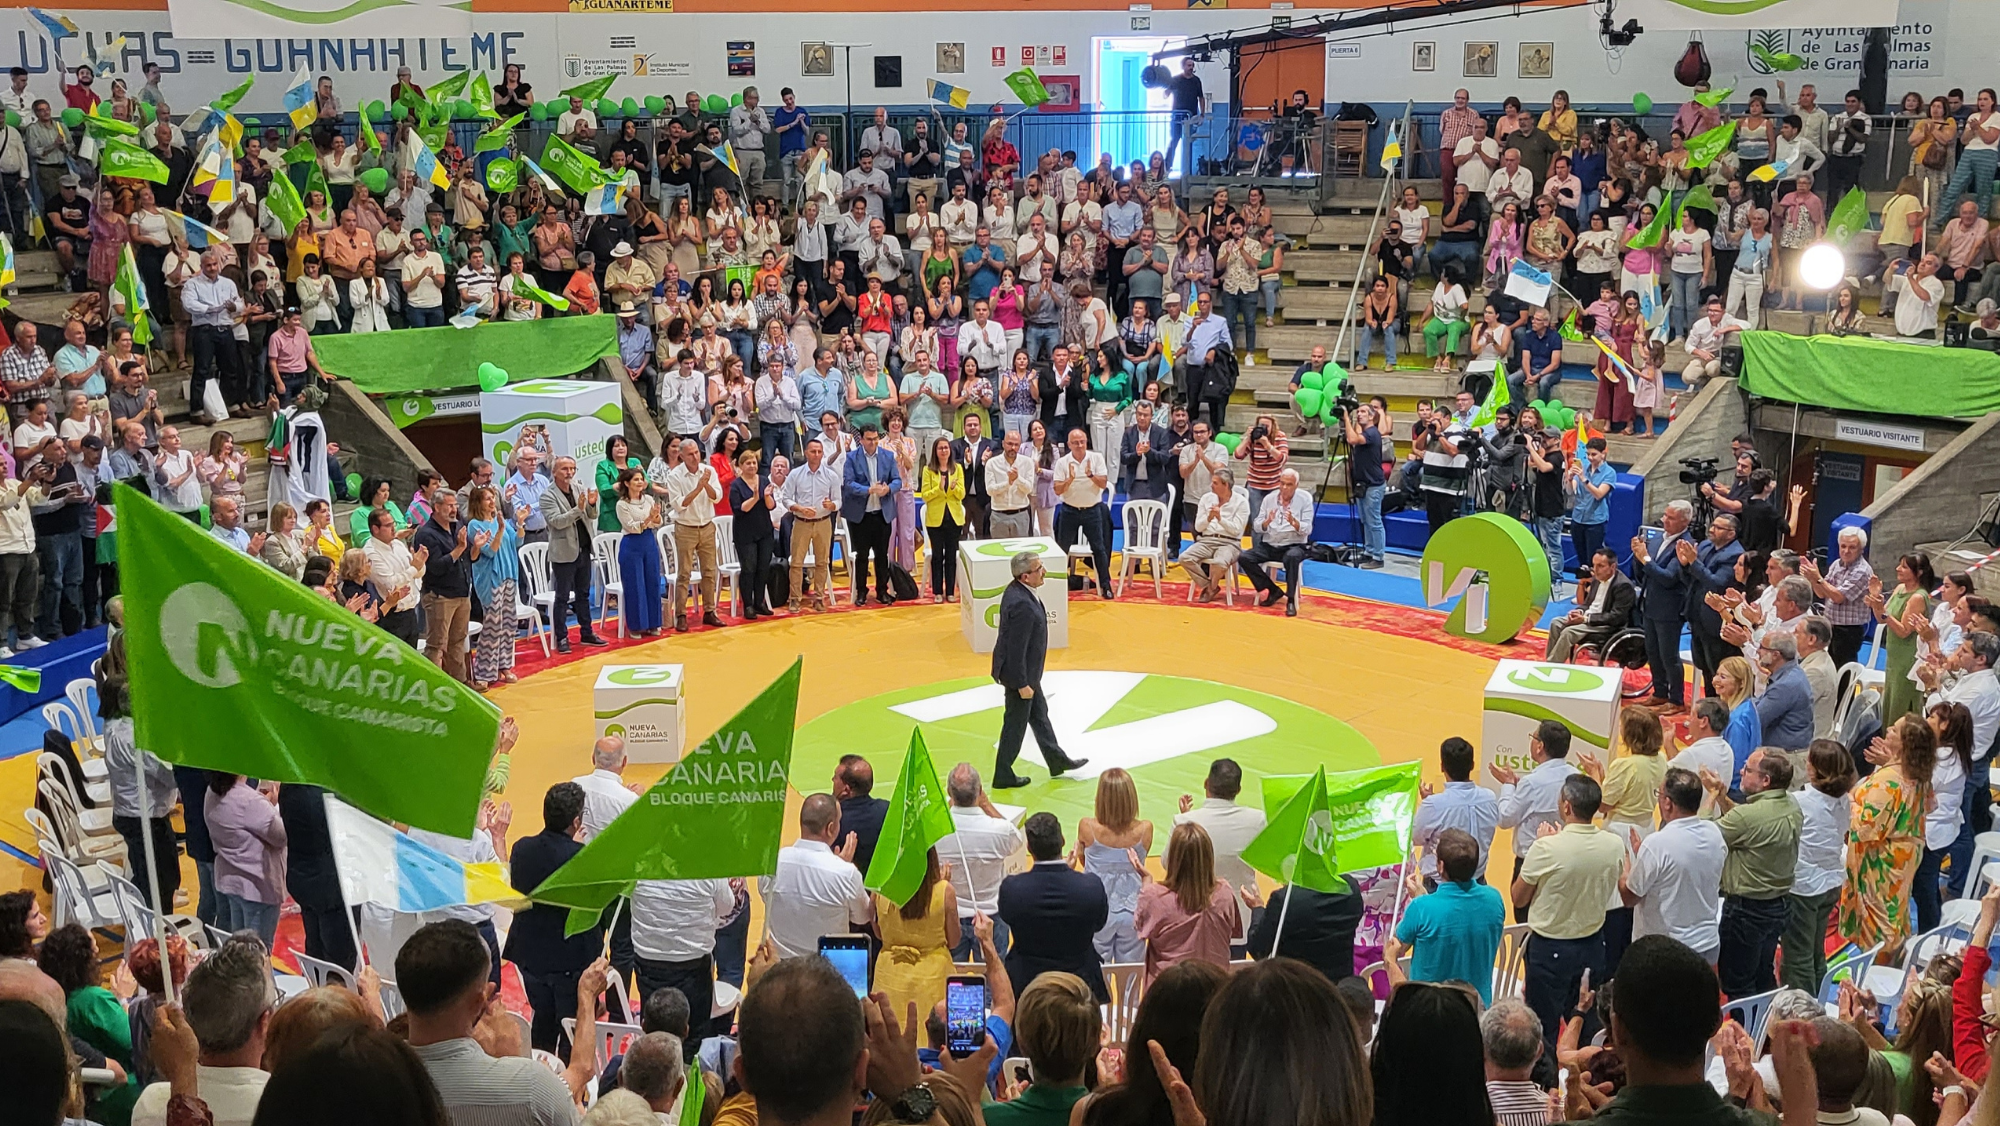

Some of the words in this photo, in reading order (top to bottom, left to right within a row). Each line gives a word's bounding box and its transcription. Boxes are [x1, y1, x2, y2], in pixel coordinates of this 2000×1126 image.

[1801, 23, 1933, 39] Ayuntaento
[0, 31, 181, 73] UCHAS
[1801, 40, 1820, 54] de
[1835, 40, 1860, 53] Las
[1891, 39, 1932, 52] lmas
[1800, 57, 1819, 70] de
[1888, 56, 1929, 70] naria
[433, 400, 473, 411] VESTUARIO
[1841, 425, 1881, 438] VESTUARIO
[1882, 431, 1920, 444] VISITANTE
[264, 609, 404, 666] NUEVA
[629, 731, 668, 739] CANARIAS
[1496, 745, 1513, 754] Con
[649, 792, 716, 806] BLOQUE
